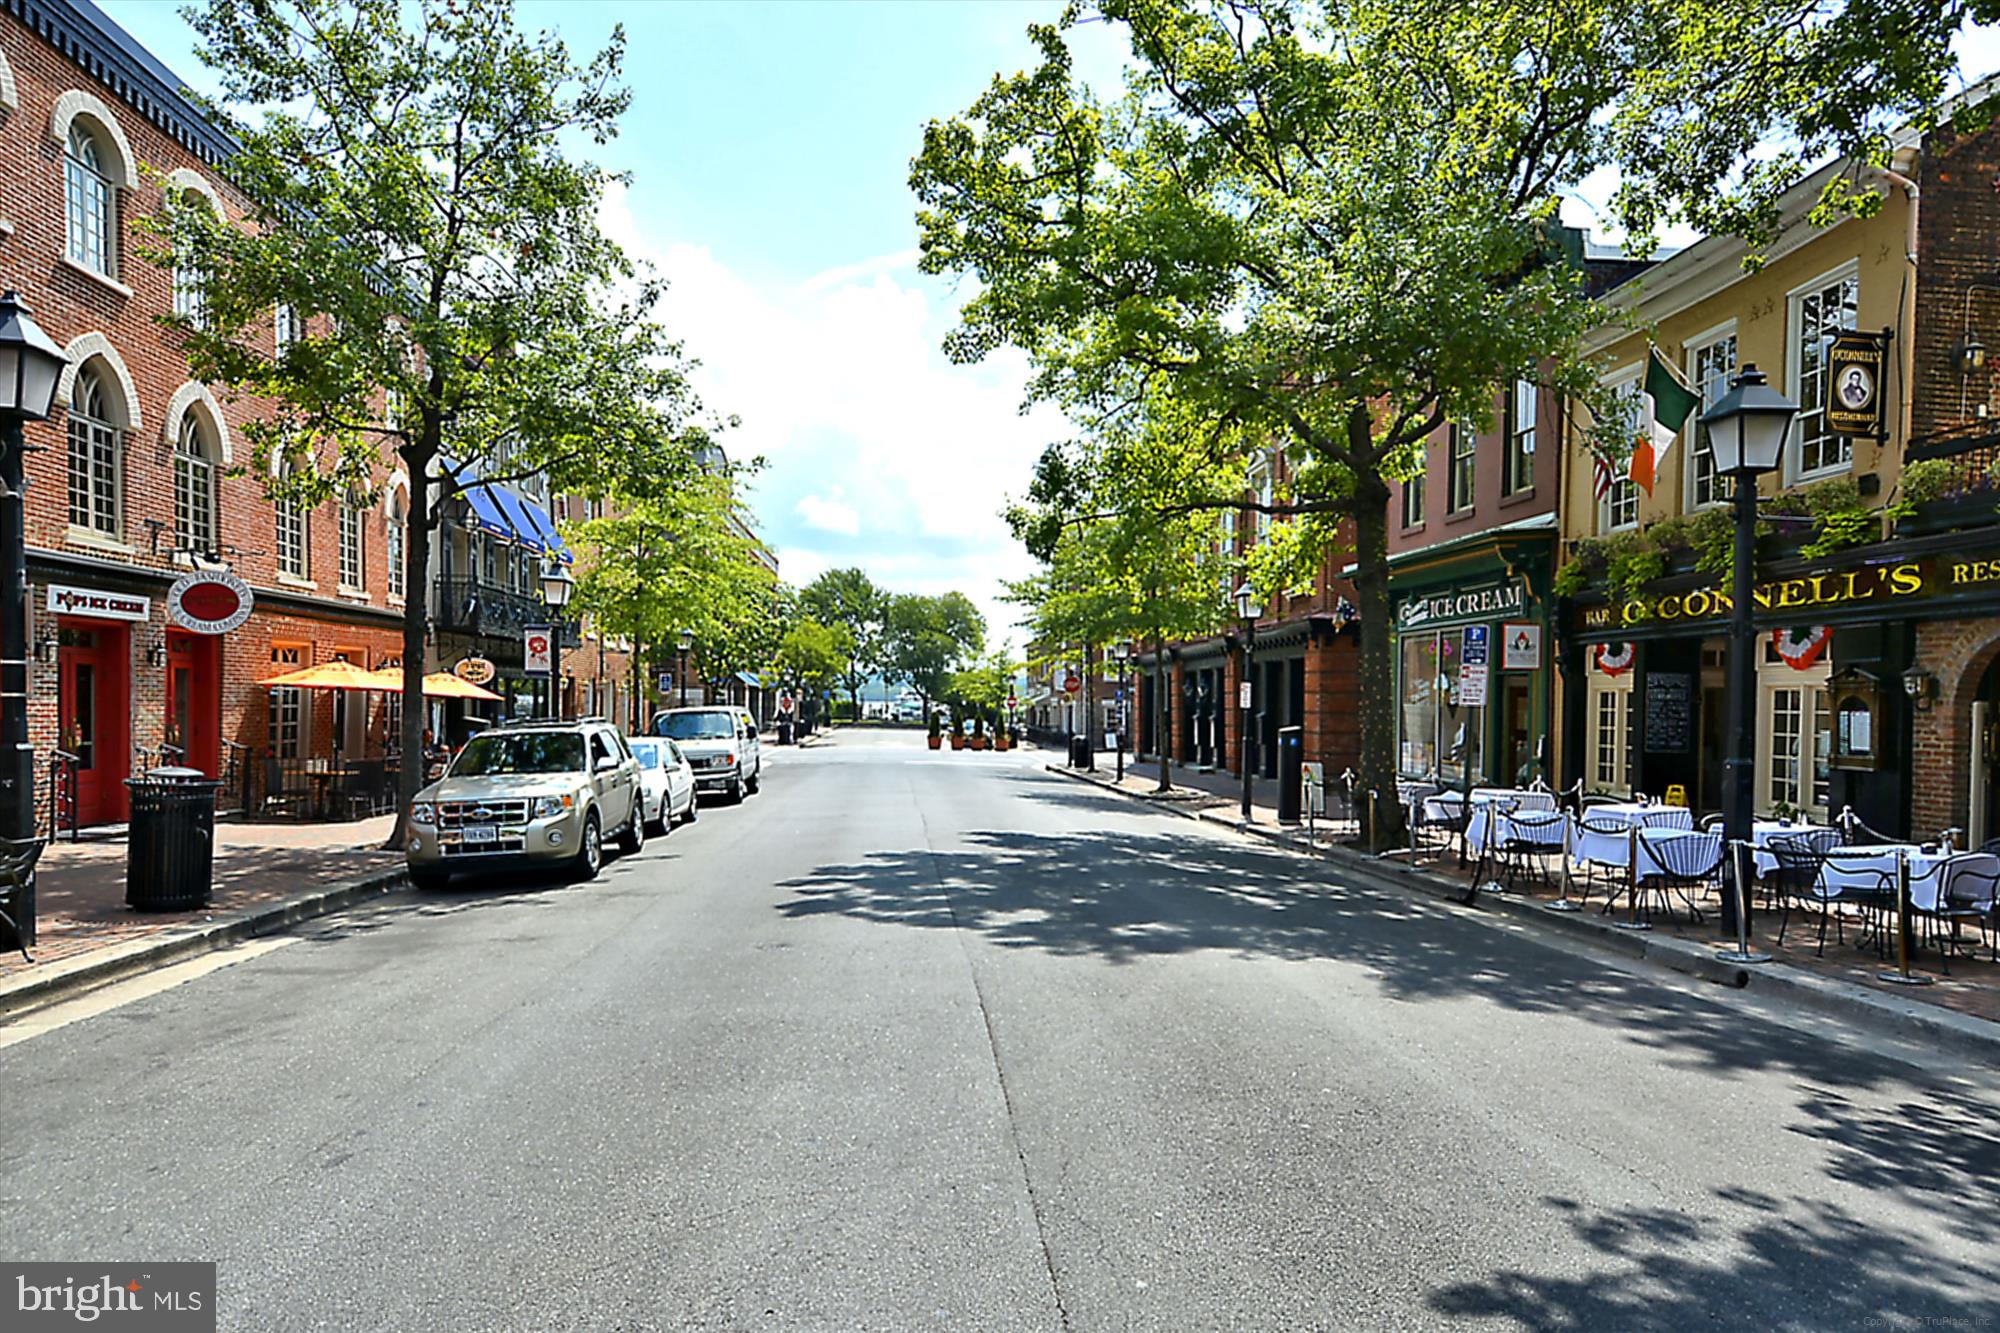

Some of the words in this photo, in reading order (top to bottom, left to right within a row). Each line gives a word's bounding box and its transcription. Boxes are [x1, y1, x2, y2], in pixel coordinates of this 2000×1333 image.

[1429, 598, 1456, 619] ICE
[1456, 585, 1521, 615] CREAM
[1585, 608, 1611, 626] BAR
[1621, 563, 1924, 625] OCONNELL'S
[1951, 558, 2000, 585] RES
[1471, 629, 1481, 640] P
